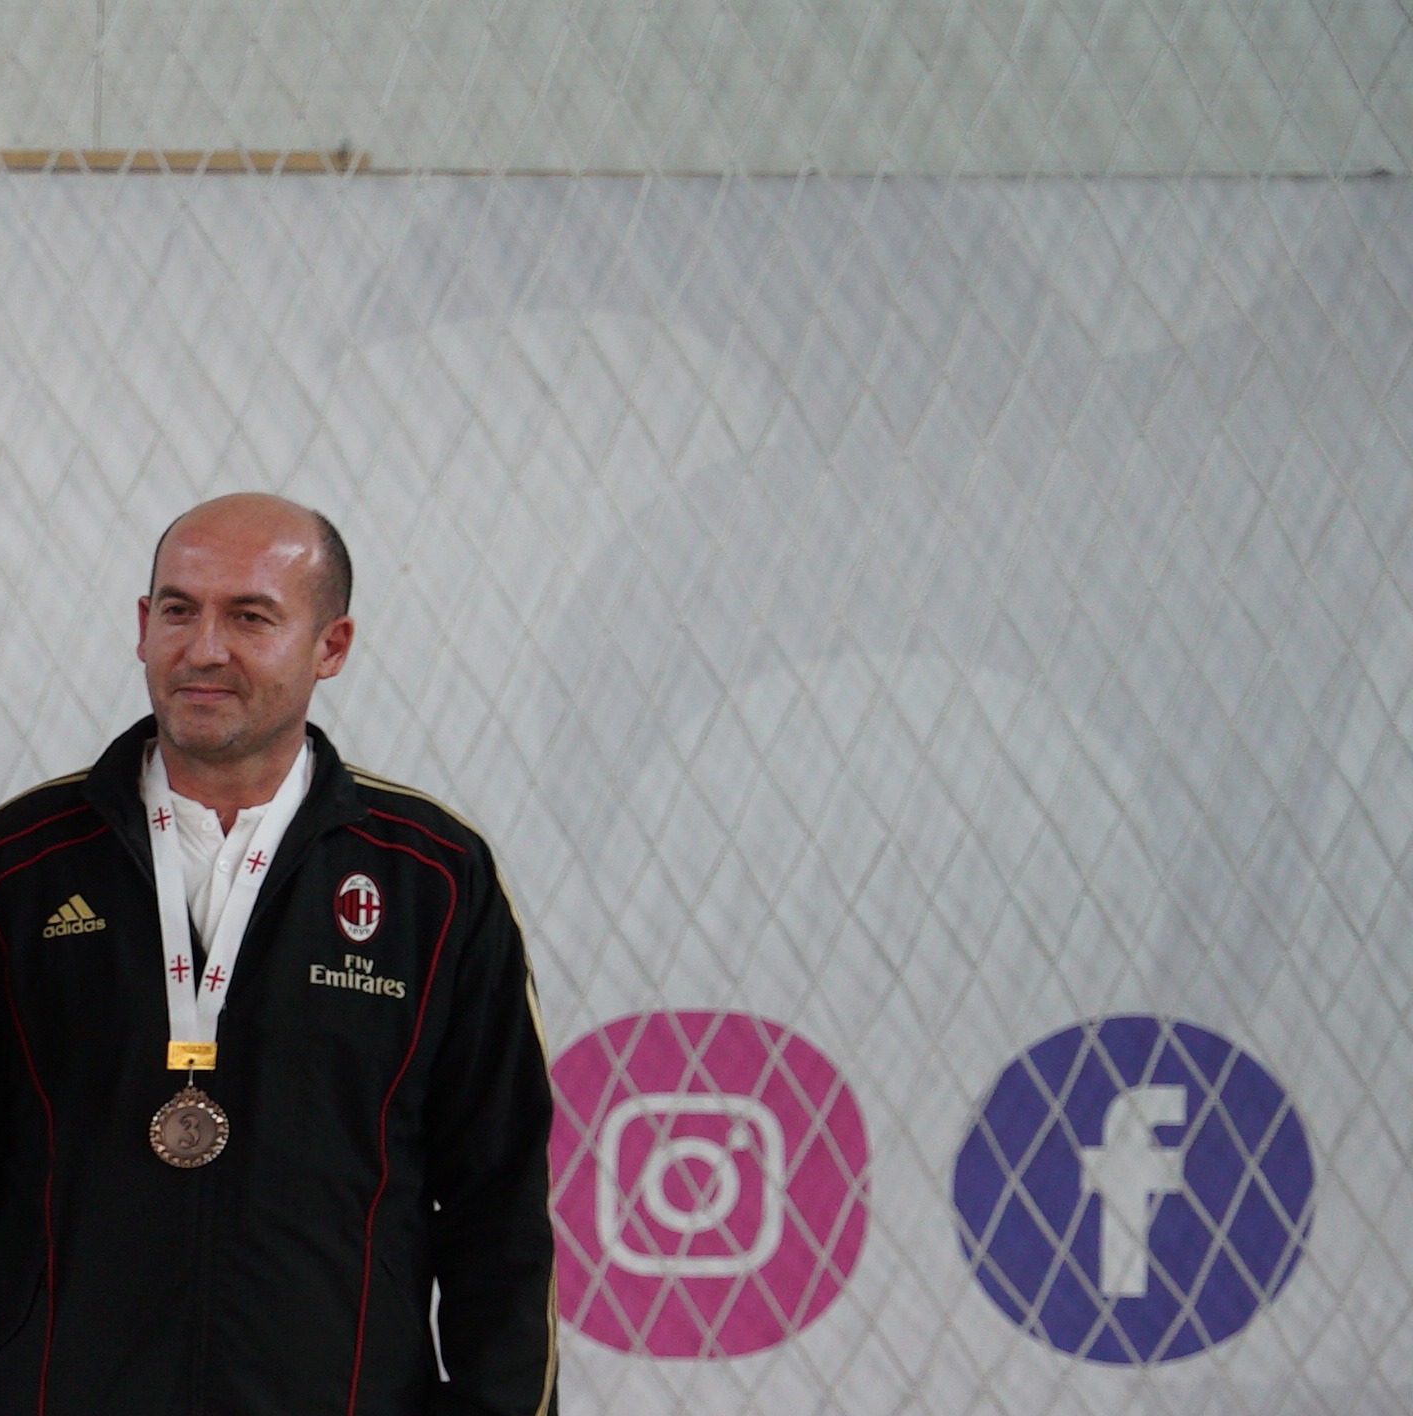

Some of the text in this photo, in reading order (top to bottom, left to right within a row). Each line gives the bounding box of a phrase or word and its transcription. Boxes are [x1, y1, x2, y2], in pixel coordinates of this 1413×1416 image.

[42, 916, 107, 939] adidas
[344, 954, 375, 975] Fly
[309, 964, 407, 999] Emirates
[177, 1113, 202, 1150] 3
